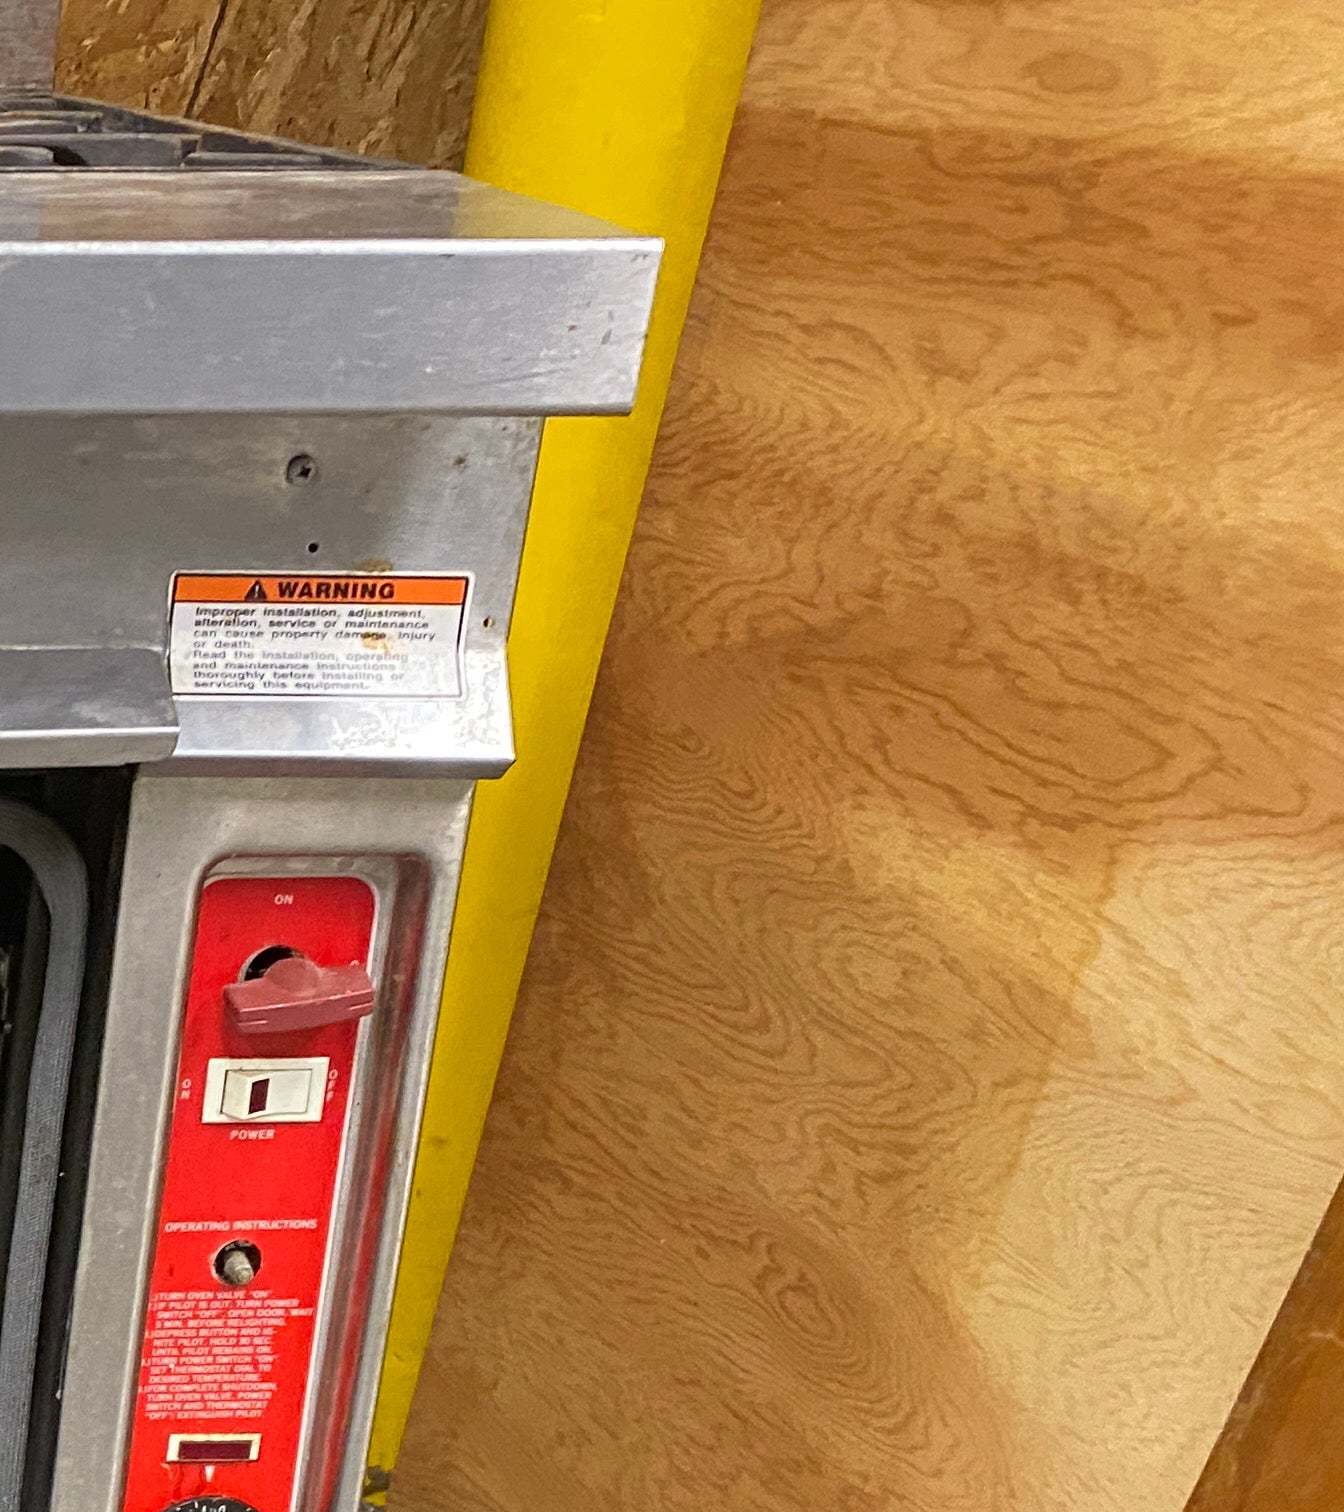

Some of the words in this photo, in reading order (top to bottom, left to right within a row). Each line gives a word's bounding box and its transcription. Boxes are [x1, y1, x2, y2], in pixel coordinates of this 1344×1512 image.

[278, 582, 395, 599] WARNING
[195, 607, 255, 619] Improper
[263, 607, 339, 619] installation,
[348, 607, 425, 620] adjustment,
[193, 617, 261, 630] alteration,
[268, 619, 316, 629] service
[323, 620, 337, 628] or
[344, 618, 430, 629] maintenance
[193, 629, 217, 638] can
[224, 629, 265, 638] cause
[271, 629, 328, 642] property
[397, 629, 436, 641] injury
[193, 641, 206, 649] or
[213, 639, 254, 649] death.
[192, 649, 226, 659] Read
[234, 649, 255, 659] the
[261, 650, 339, 662] installation,
[345, 651, 409, 664] operating
[192, 660, 217, 670] and
[225, 660, 310, 670] maintenance
[316, 660, 397, 671] instructions
[193, 670, 266, 683] thoroughly
[273, 670, 315, 680] before
[321, 670, 383, 684] installing
[390, 672, 405, 681] or
[193, 680, 255, 692] servicing
[263, 680, 288, 690] this
[295, 680, 369, 693] equipment.
[274, 894, 295, 905] ON
[181, 1078, 192, 1099] ON
[325, 1069, 338, 1102] OFF
[230, 1129, 275, 1140] POWER
[165, 1221, 231, 1232] OPERATING
[232, 1218, 318, 1231] INSTRUCTIONS
[187, 1291, 214, 1300] OVEN
[216, 1290, 246, 1299] VALVE
[168, 1300, 196, 1309] PILOT
[235, 1300, 262, 1309] TURN
[263, 1299, 300, 1308] POWER
[157, 1310, 193, 1319] SWITCH
[227, 1309, 255, 1318] OPEN
[289, 1308, 314, 1317] WAIT
[187, 1319, 224, 1328] BEFORE
[199, 1328, 238, 1337] BUTTON
[240, 1328, 262, 1337] AND
[209, 1337, 237, 1346] HOLD
[152, 1347, 179, 1356] UNTIL
[180, 1347, 210, 1356] PILOT
[211, 1346, 254, 1355] REMAINS
[151, 1356, 179, 1366] TURN
[179, 1356, 214, 1365] POWER
[215, 1355, 252, 1364] SWITCH
[233, 1364, 255, 1373] DIAL
[257, 1363, 273, 1373] TO
[148, 1375, 190, 1384] DESIRED
[169, 1383, 220, 1393] COMPLETE
[146, 1393, 173, 1402] TURN
[174, 1393, 201, 1402] OVEN
[237, 1391, 273, 1400] POWER
[145, 1402, 182, 1411] SWITCH
[183, 1401, 205, 1410] AND
[206, 1400, 269, 1410] THERMOSTAT
